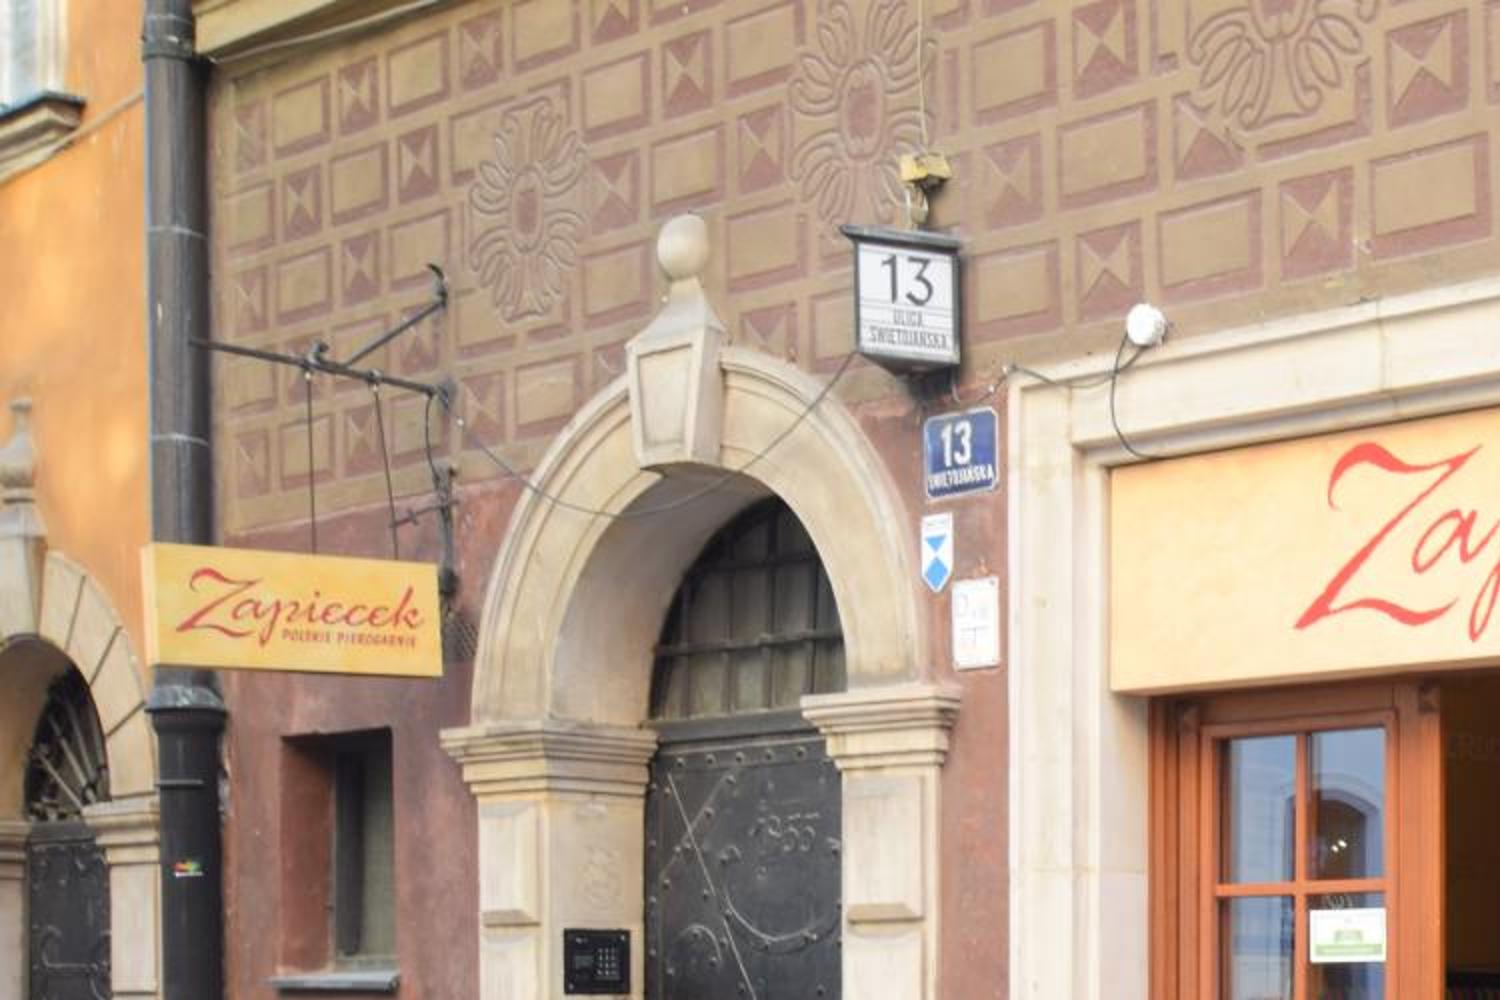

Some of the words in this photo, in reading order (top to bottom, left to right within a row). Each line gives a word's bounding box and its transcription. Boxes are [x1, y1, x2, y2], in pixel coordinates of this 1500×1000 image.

[881, 253, 934, 307] 13
[941, 420, 972, 468] 13
[176, 566, 426, 648] Zapiecek
